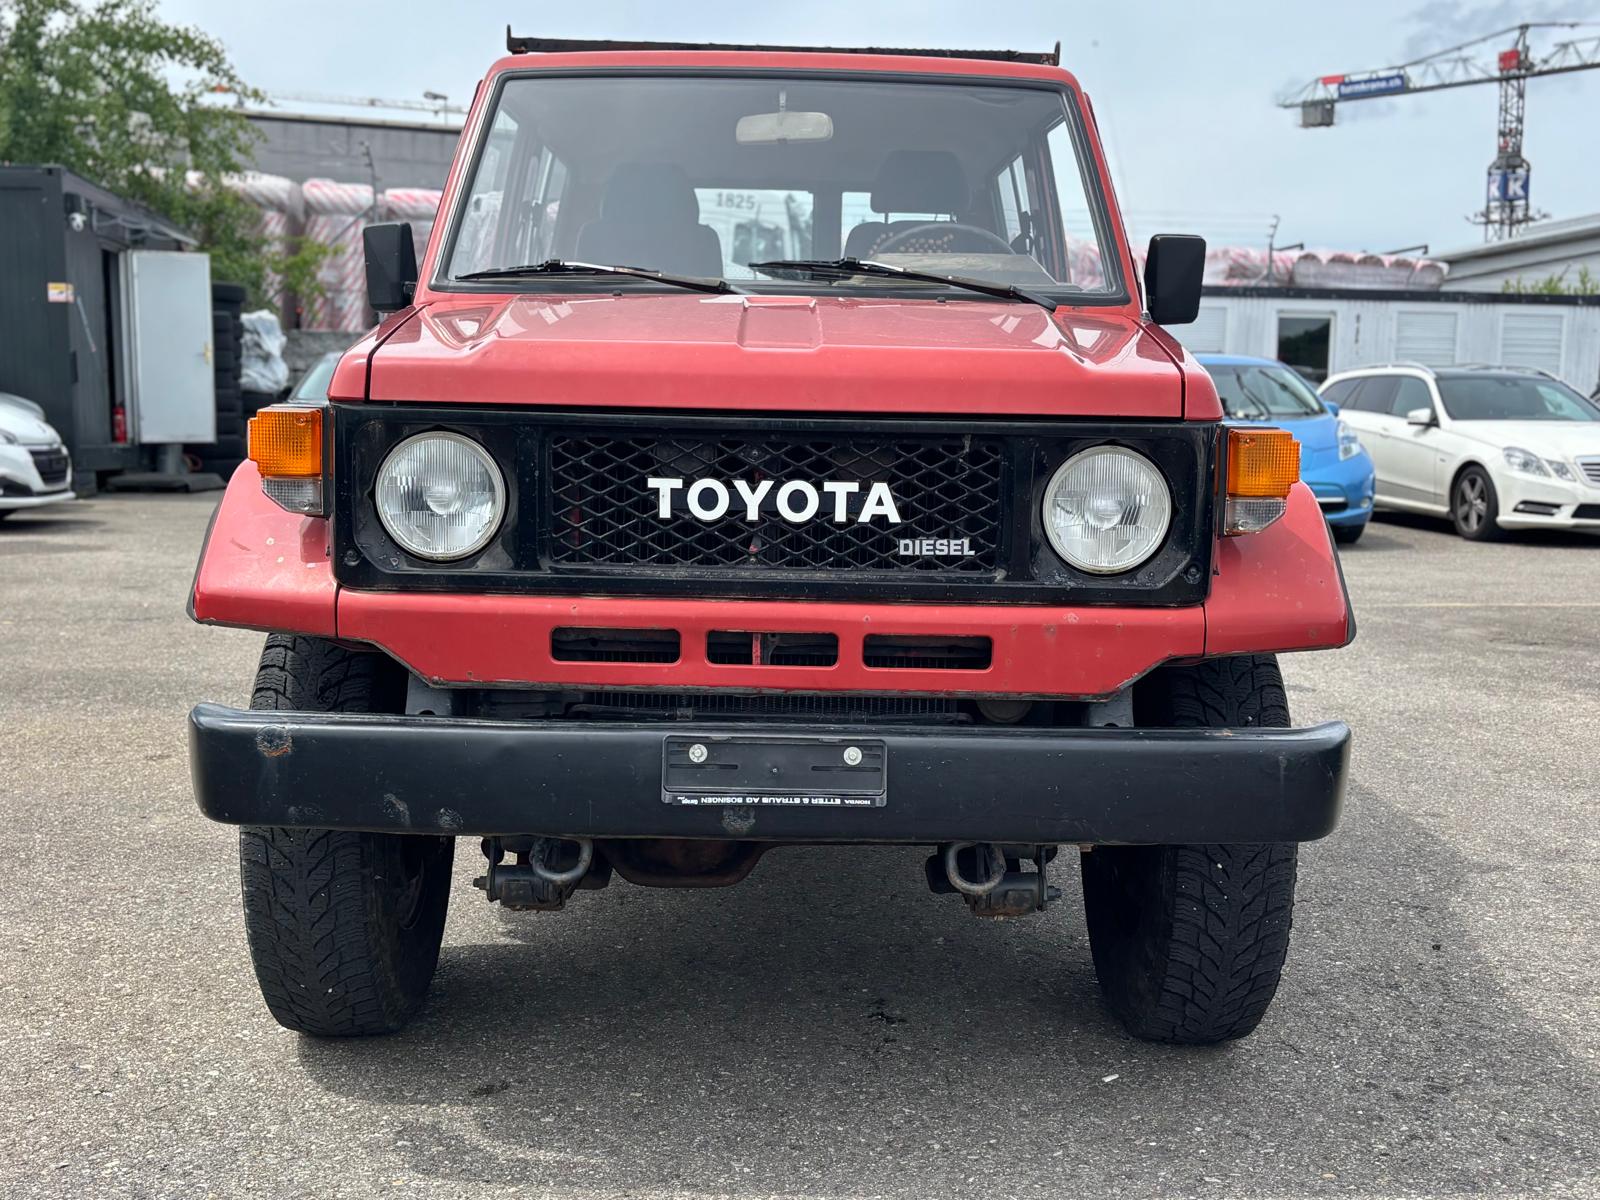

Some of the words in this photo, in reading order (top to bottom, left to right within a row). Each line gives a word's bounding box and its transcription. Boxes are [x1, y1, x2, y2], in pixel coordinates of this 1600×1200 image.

[1507, 175, 1527, 198] K
[716, 191, 755, 210] 1825
[647, 477, 901, 523] TOYOTA
[899, 537, 976, 556] DIESEL
[811, 797, 841, 805] ETTER
